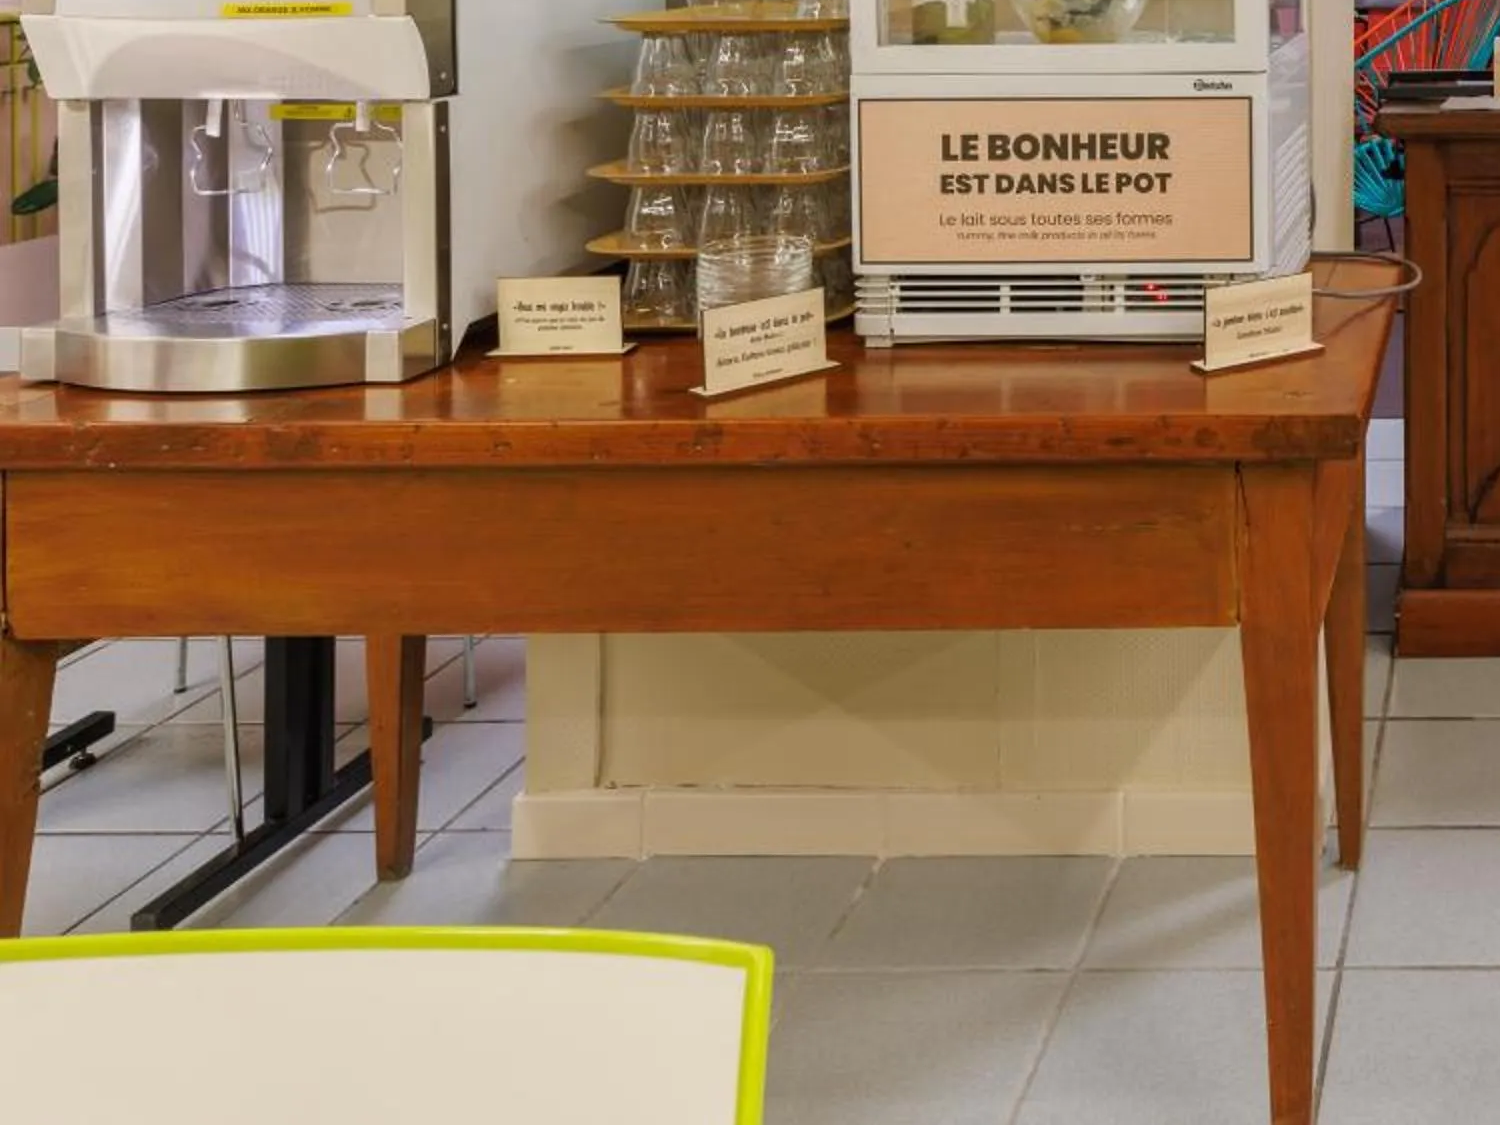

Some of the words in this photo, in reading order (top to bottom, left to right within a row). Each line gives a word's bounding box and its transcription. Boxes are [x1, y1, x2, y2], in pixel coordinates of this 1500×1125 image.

[941, 134, 979, 162] LE
[987, 132, 1171, 162] BONHEUR
[940, 174, 990, 195] EST
[995, 173, 1076, 195] DANS
[1081, 173, 1110, 195] LE
[1115, 172, 1173, 194] POT
[939, 213, 957, 226] Le
[961, 212, 984, 226] lait
[989, 215, 1027, 226] sous
[1031, 213, 1081, 226] toutes
[1085, 214, 1113, 226] ses
[1116, 211, 1173, 226] formes
